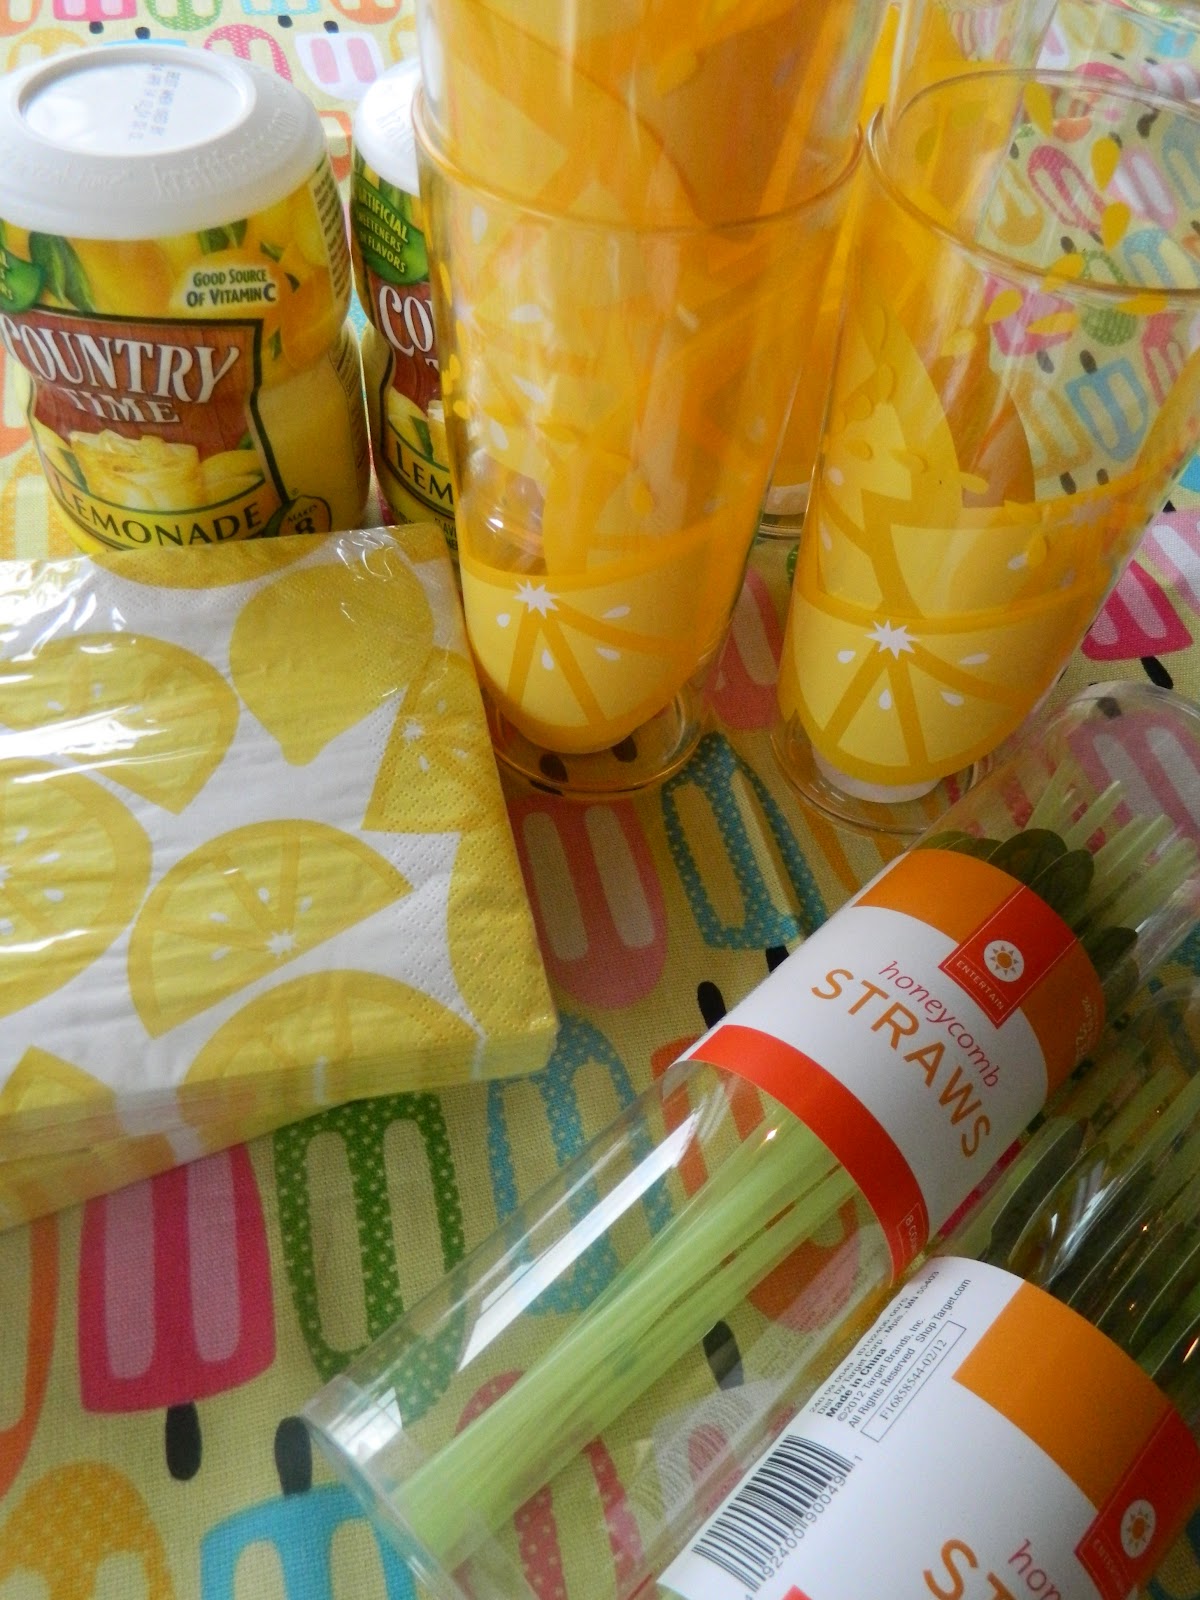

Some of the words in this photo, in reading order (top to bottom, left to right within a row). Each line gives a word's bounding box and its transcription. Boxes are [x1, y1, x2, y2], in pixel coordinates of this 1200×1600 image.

[359, 212, 402, 252] EETENERS
[367, 235, 406, 274] FLAVORS
[186, 290, 206, 308] OF
[209, 286, 262, 306] VITAMIN
[263, 282, 277, 303] C
[192, 271, 227, 288] GOOD
[229, 268, 267, 285] SOURCE
[379, 284, 434, 358] CO
[0, 313, 240, 404] COUNTRY
[56, 386, 181, 423] TIME
[53, 473, 264, 547] LEMONADE
[956, 960, 1005, 1010] ENTERTAIN
[878, 960, 1001, 1088] honeycomb
[811, 968, 990, 1158] STRAWS
[826, 1389, 853, 1418] Made
[850, 1376, 863, 1390] in
[860, 1347, 887, 1376] China
[848, 1408, 862, 1428] All
[859, 1386, 885, 1416] Rights
[880, 1347, 916, 1388] Reserved
[915, 1321, 937, 1344] Shop
[932, 1278, 972, 1321] Target.com
[862, 1362, 888, 1392] Target
[884, 1334, 912, 1365] Brands,
[908, 1318, 926, 1334] Inc.
